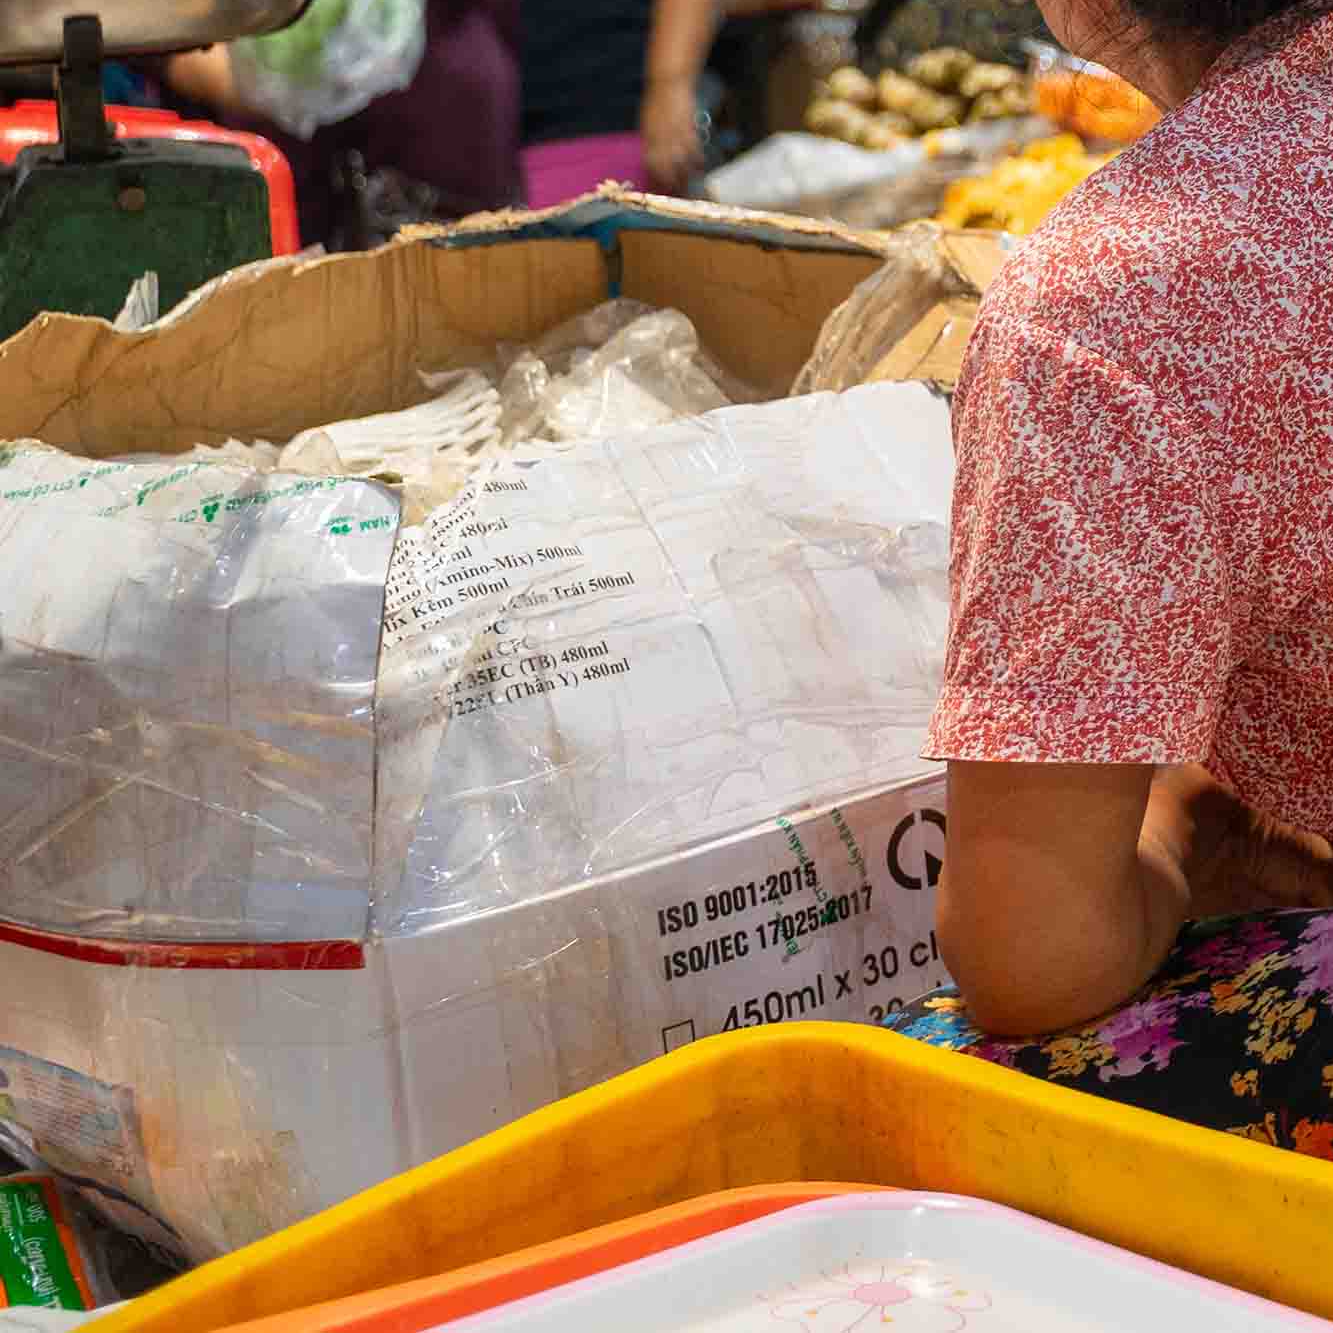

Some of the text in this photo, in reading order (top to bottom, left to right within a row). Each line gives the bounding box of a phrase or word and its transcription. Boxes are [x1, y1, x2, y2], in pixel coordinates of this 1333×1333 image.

[561, 640, 609, 665] 480ml
[582, 657, 632, 682] 480ml
[658, 901, 699, 937] ISO
[704, 861, 818, 921] 9001:2015
[663, 931, 750, 982] ISO/IEC
[756, 885, 873, 950] 17025:2017
[722, 973, 826, 1034] 450ml
[834, 970, 853, 1000] x
[862, 945, 899, 987] 30
